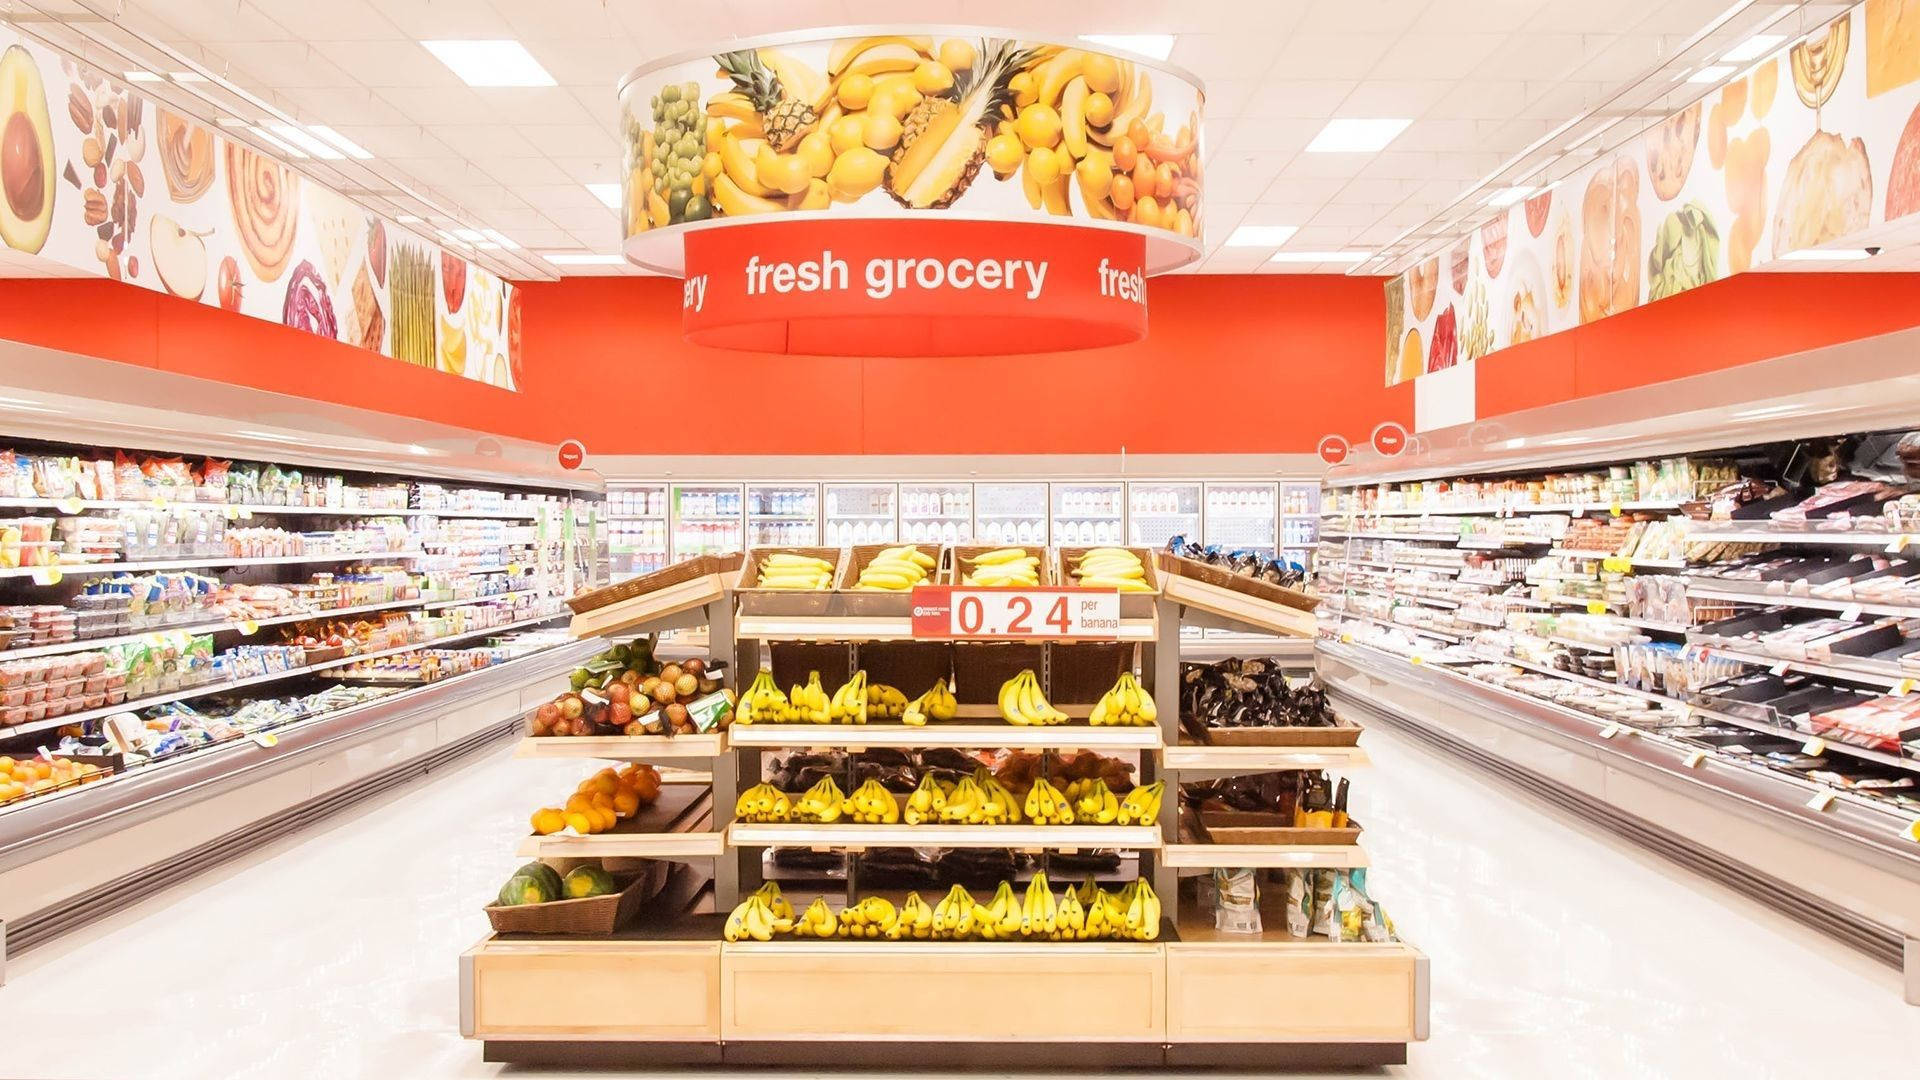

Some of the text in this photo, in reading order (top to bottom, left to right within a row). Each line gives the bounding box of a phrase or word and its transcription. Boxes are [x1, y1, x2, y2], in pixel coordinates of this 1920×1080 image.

[746, 250, 1049, 299] fresh grocery
[1098, 258, 1145, 305] fresh
[959, 596, 1072, 634] 0.24
[1081, 600, 1098, 613] per
[1081, 616, 1118, 628] banana
